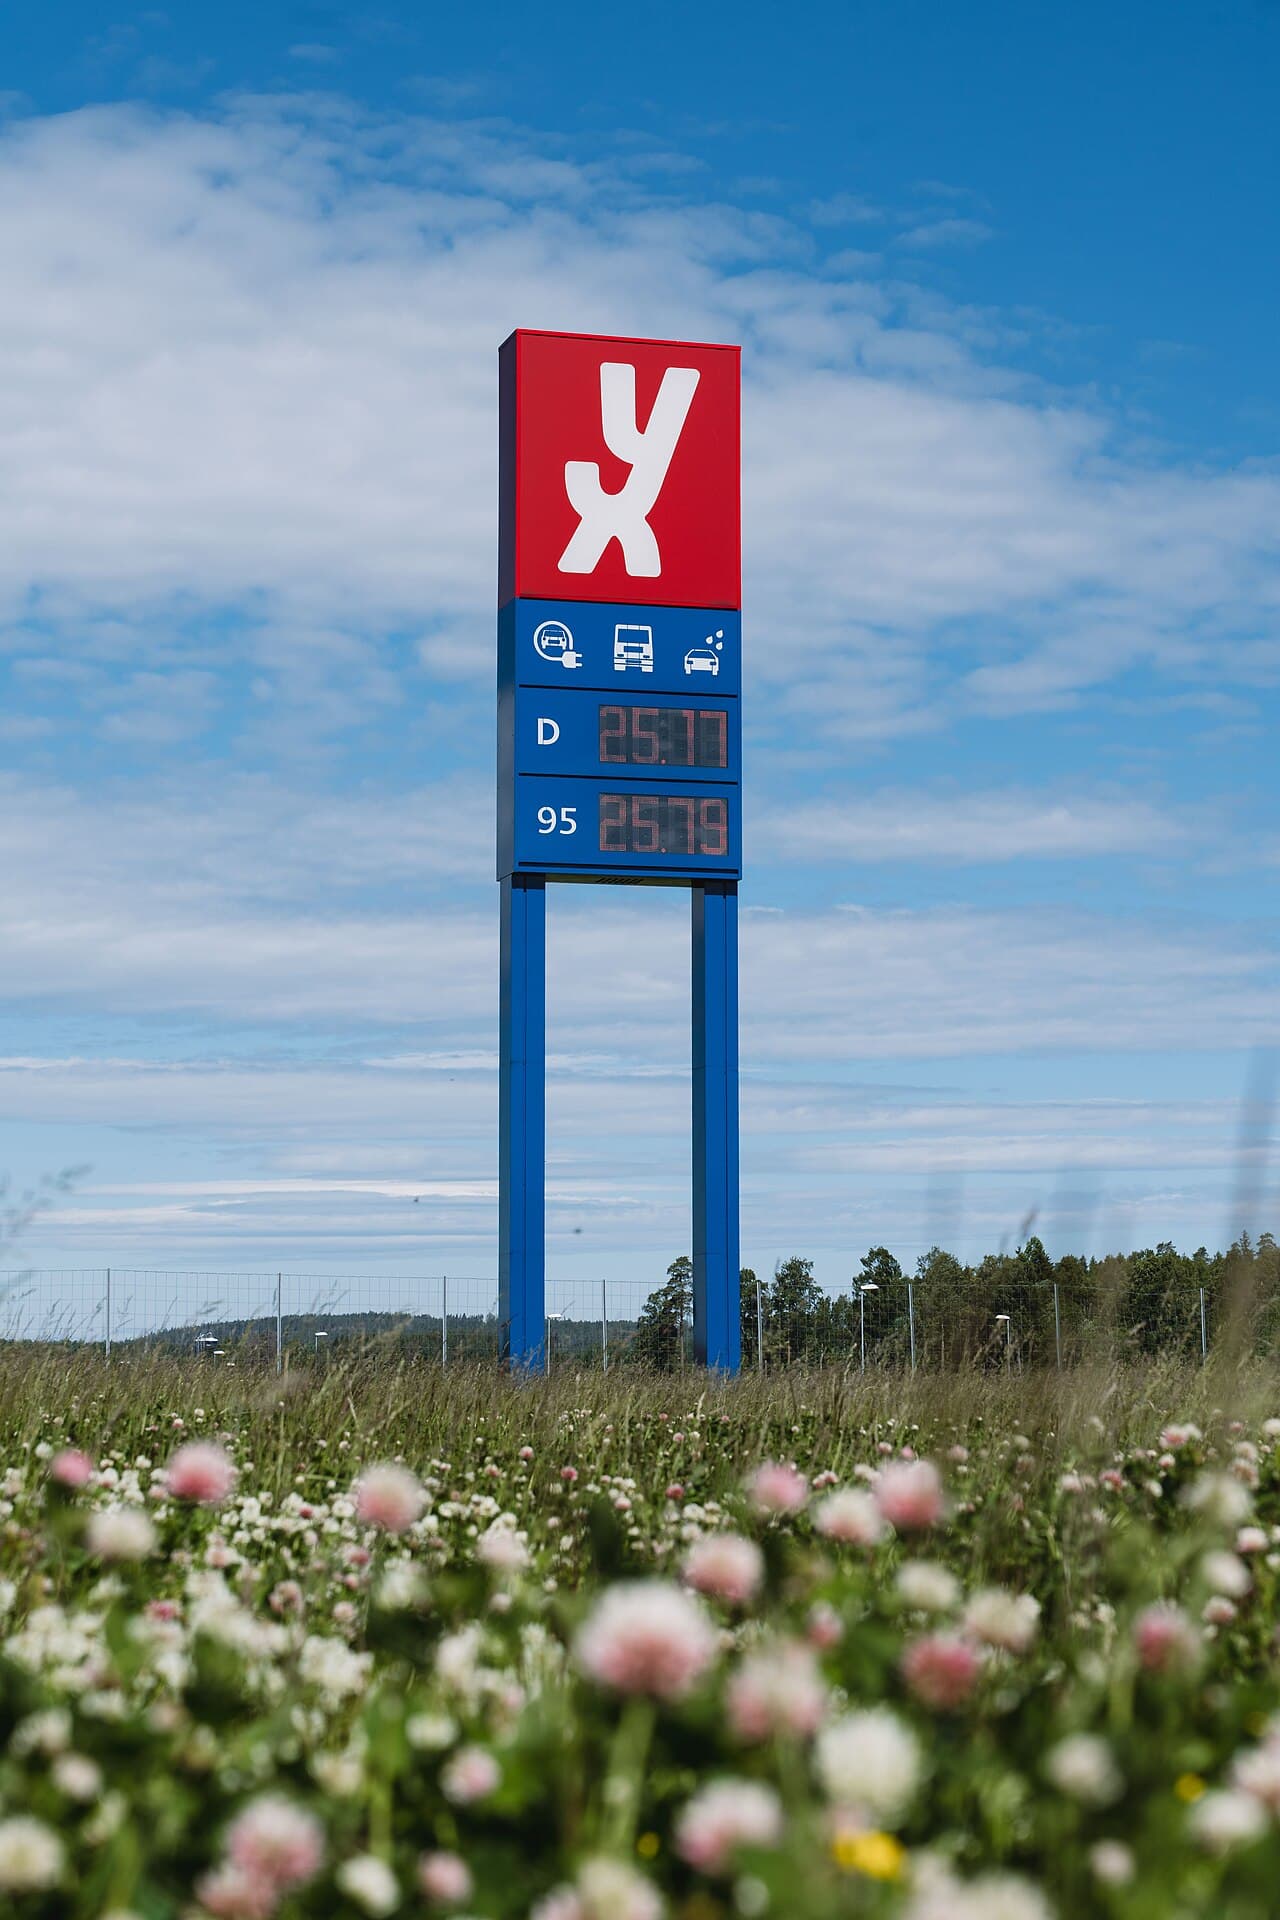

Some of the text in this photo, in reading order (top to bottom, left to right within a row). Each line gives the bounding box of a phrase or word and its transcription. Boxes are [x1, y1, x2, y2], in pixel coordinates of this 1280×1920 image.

[537, 718, 560, 745] D
[537, 794, 728, 855] 95 25.79
